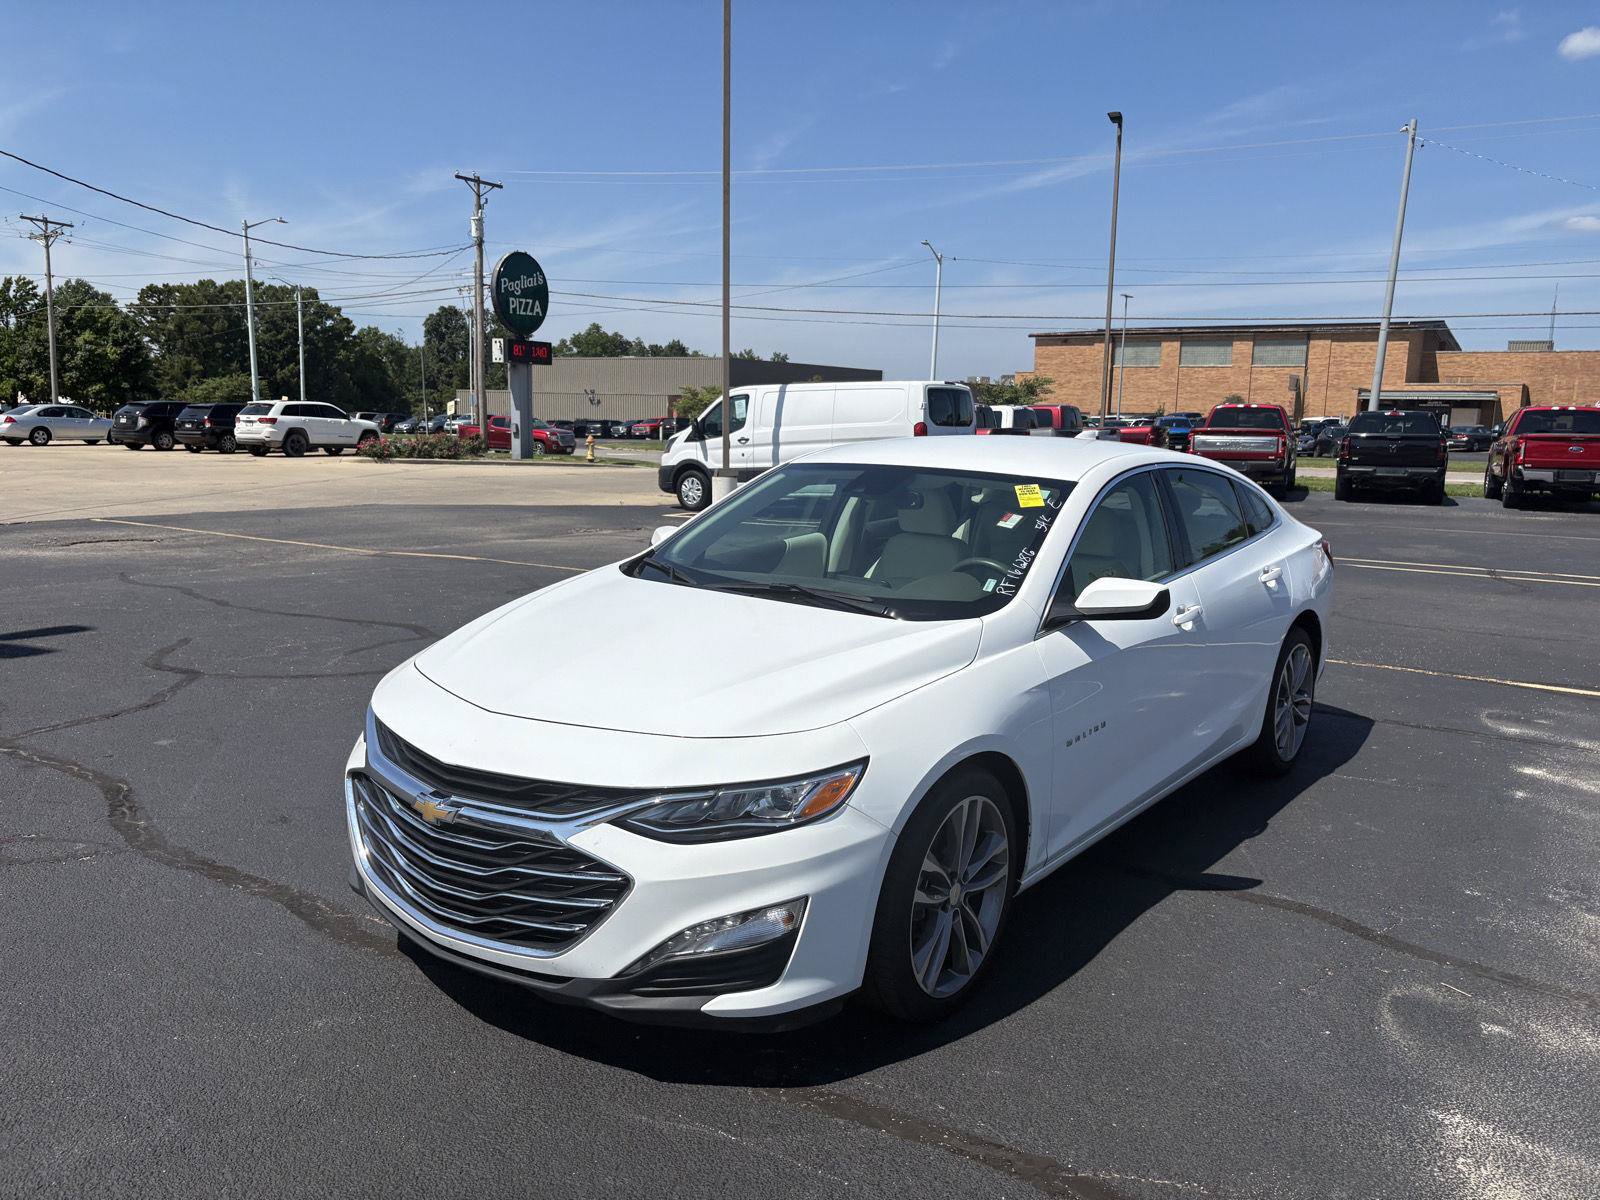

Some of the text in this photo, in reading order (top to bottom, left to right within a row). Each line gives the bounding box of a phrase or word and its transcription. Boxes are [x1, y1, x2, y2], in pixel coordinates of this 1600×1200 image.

[501, 272, 543, 295] Pagliai's
[509, 297, 542, 316] PIZZA
[1066, 720, 1106, 747] MALIBU
